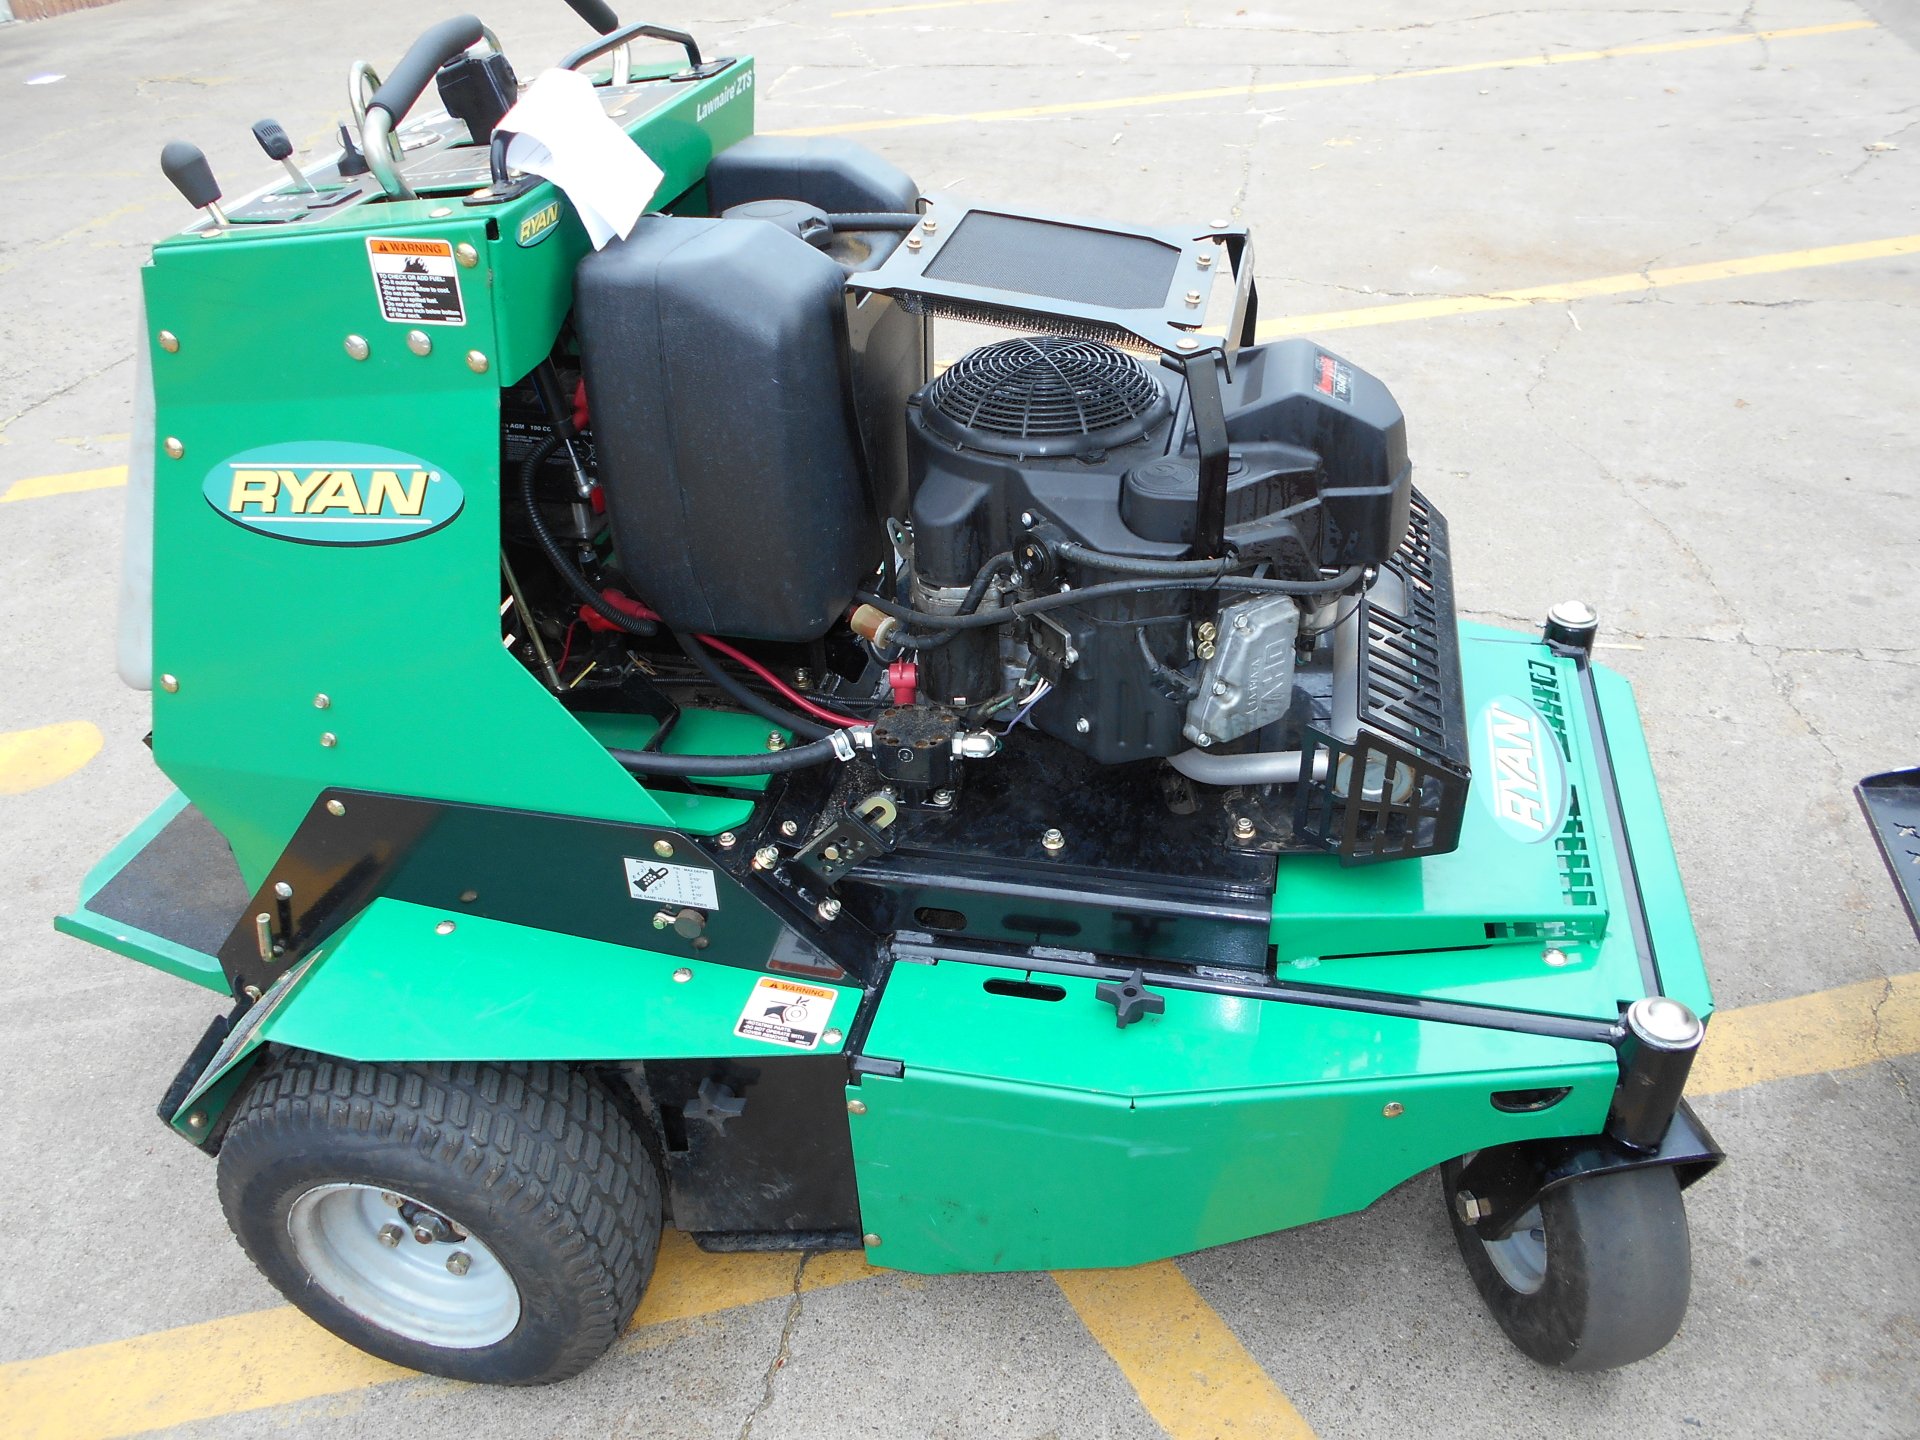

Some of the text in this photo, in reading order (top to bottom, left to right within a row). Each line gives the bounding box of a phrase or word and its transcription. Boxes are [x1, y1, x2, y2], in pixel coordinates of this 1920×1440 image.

[697, 69, 753, 122] Lawnaire ZTS
[520, 203, 559, 243] RYAN
[390, 242, 442, 254] WARNING
[228, 470, 430, 516] RYAN
[1490, 702, 1545, 832] RYAN
[781, 984, 825, 997] WARNING
